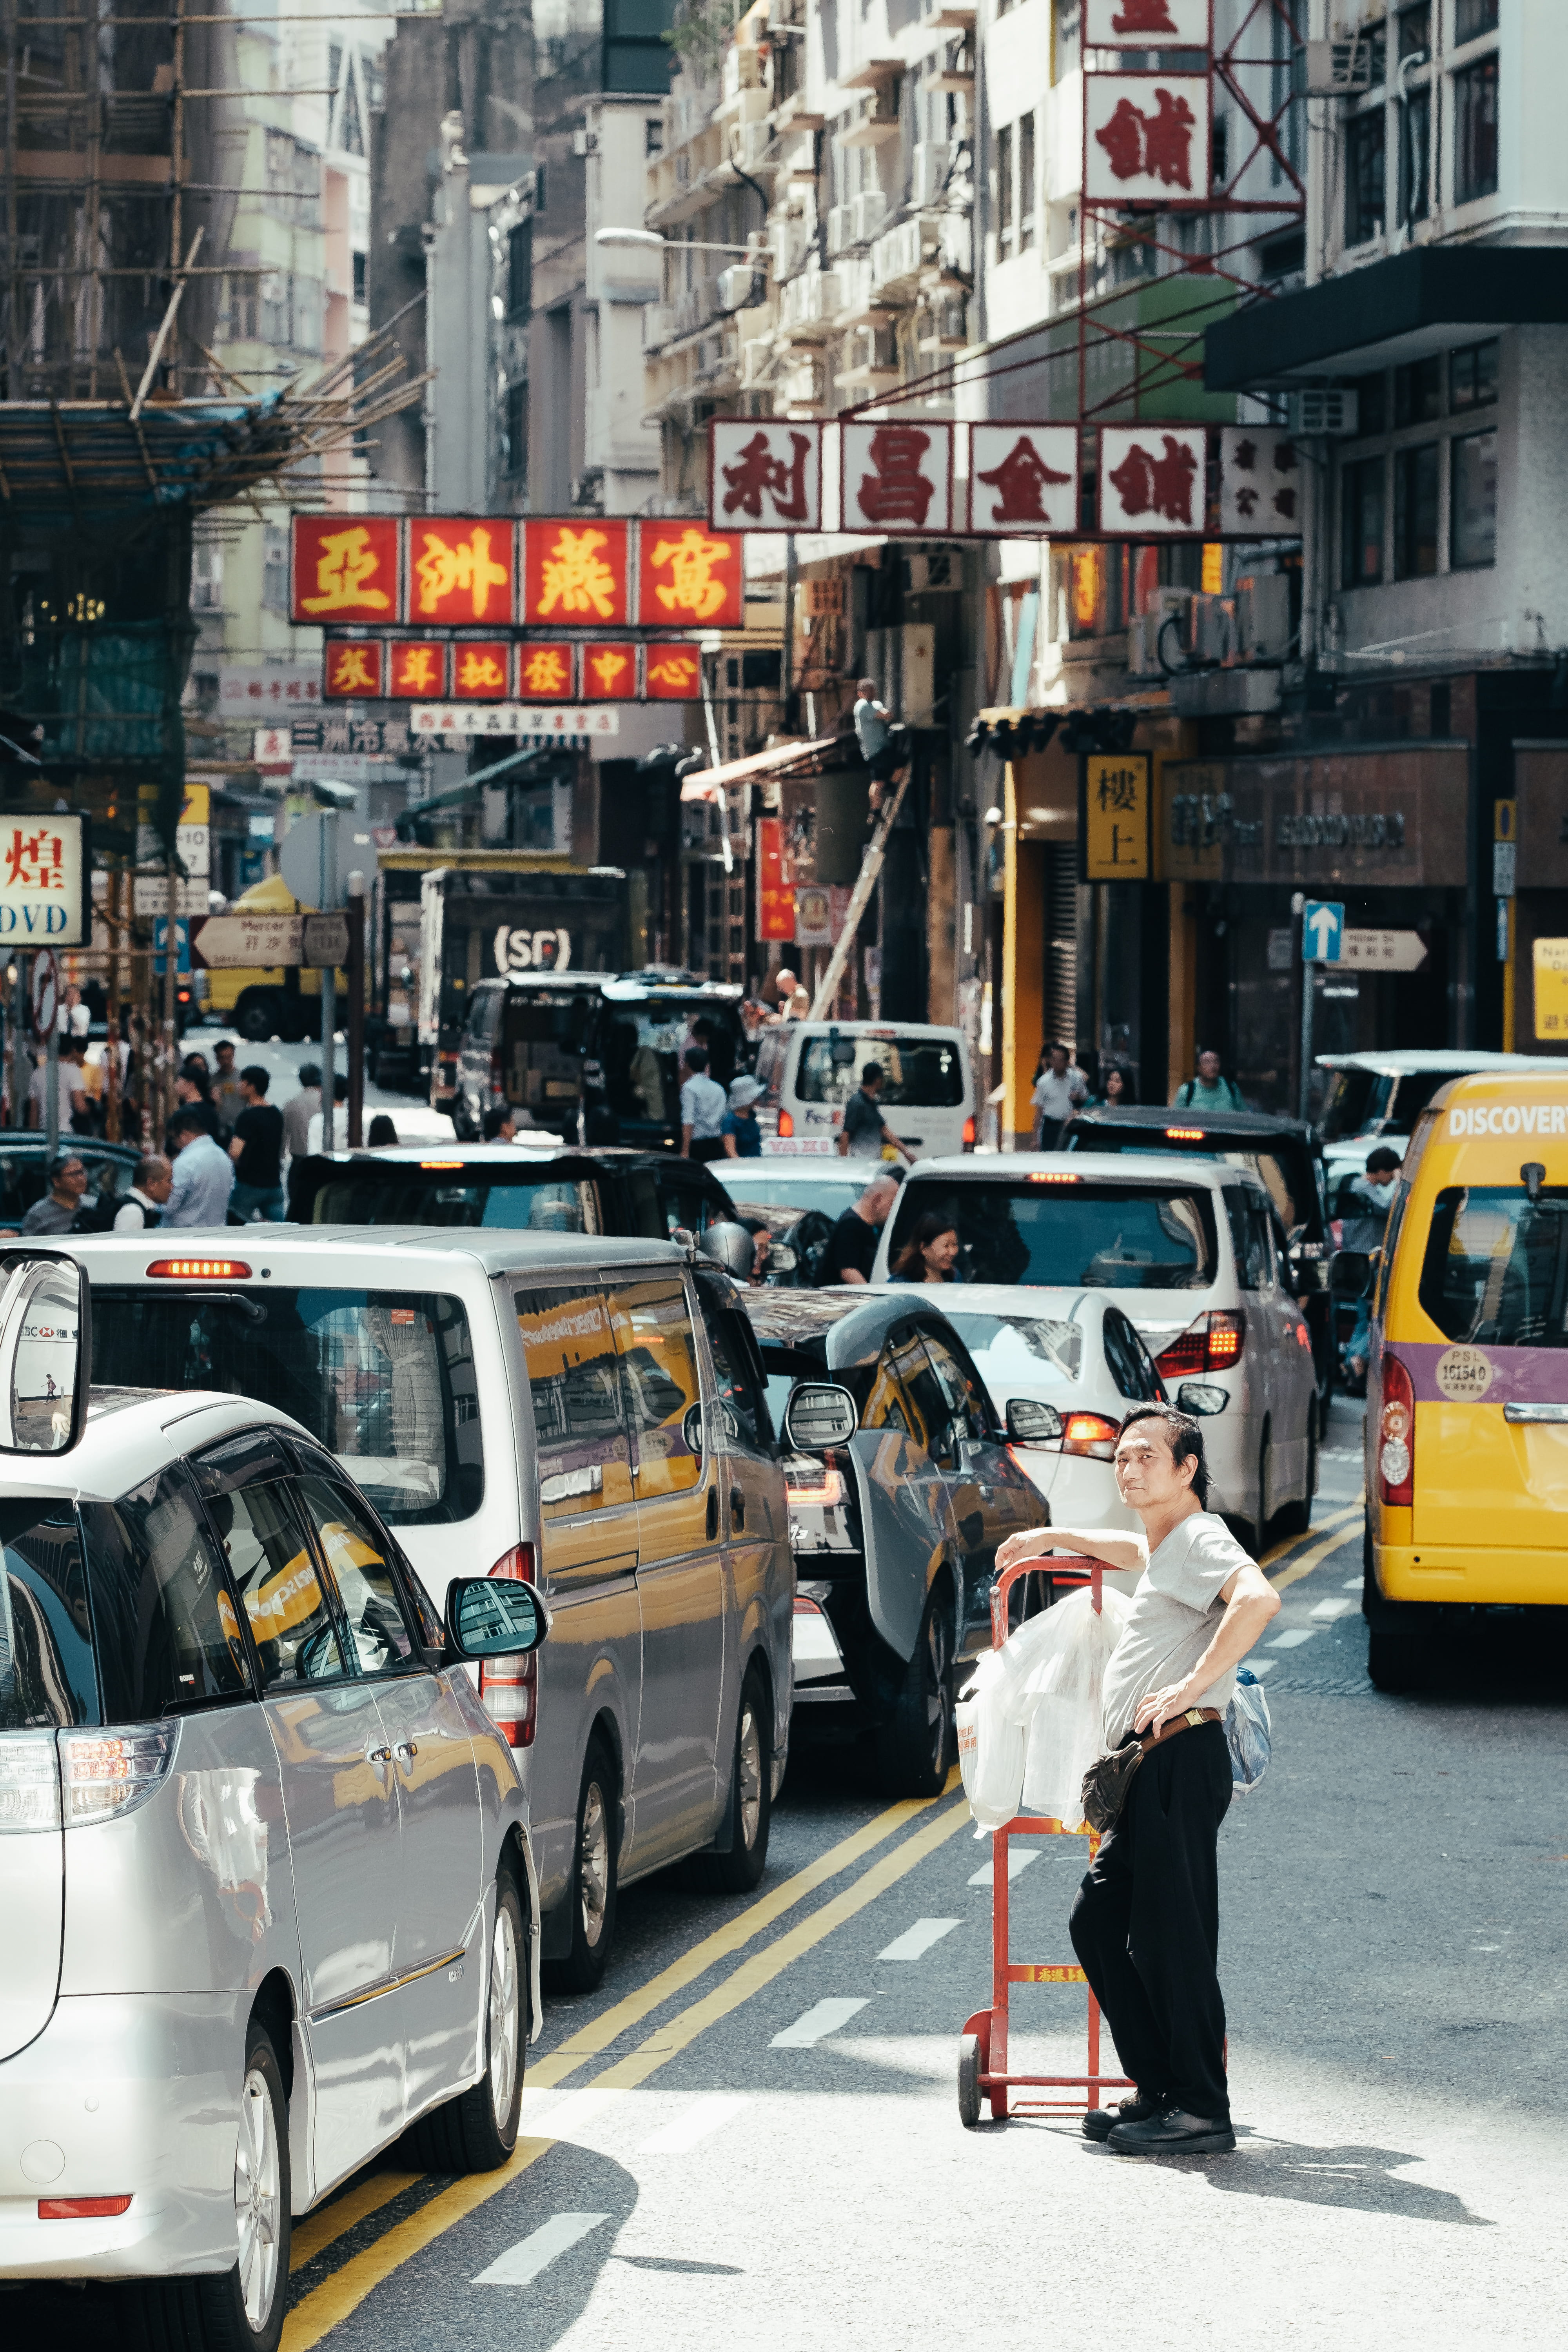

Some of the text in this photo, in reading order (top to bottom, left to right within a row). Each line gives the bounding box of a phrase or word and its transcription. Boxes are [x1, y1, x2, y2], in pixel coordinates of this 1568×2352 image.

[301, 526, 731, 619] 亞洲燕窩
[1096, 768, 1137, 865] 樓上
[5, 828, 65, 888] 煌
[0, 903, 68, 933] DVD
[1449, 1105, 1568, 1136] DISCOVER
[769, 1141, 829, 1152] TAXI
[1452, 1350, 1481, 1362] PSL
